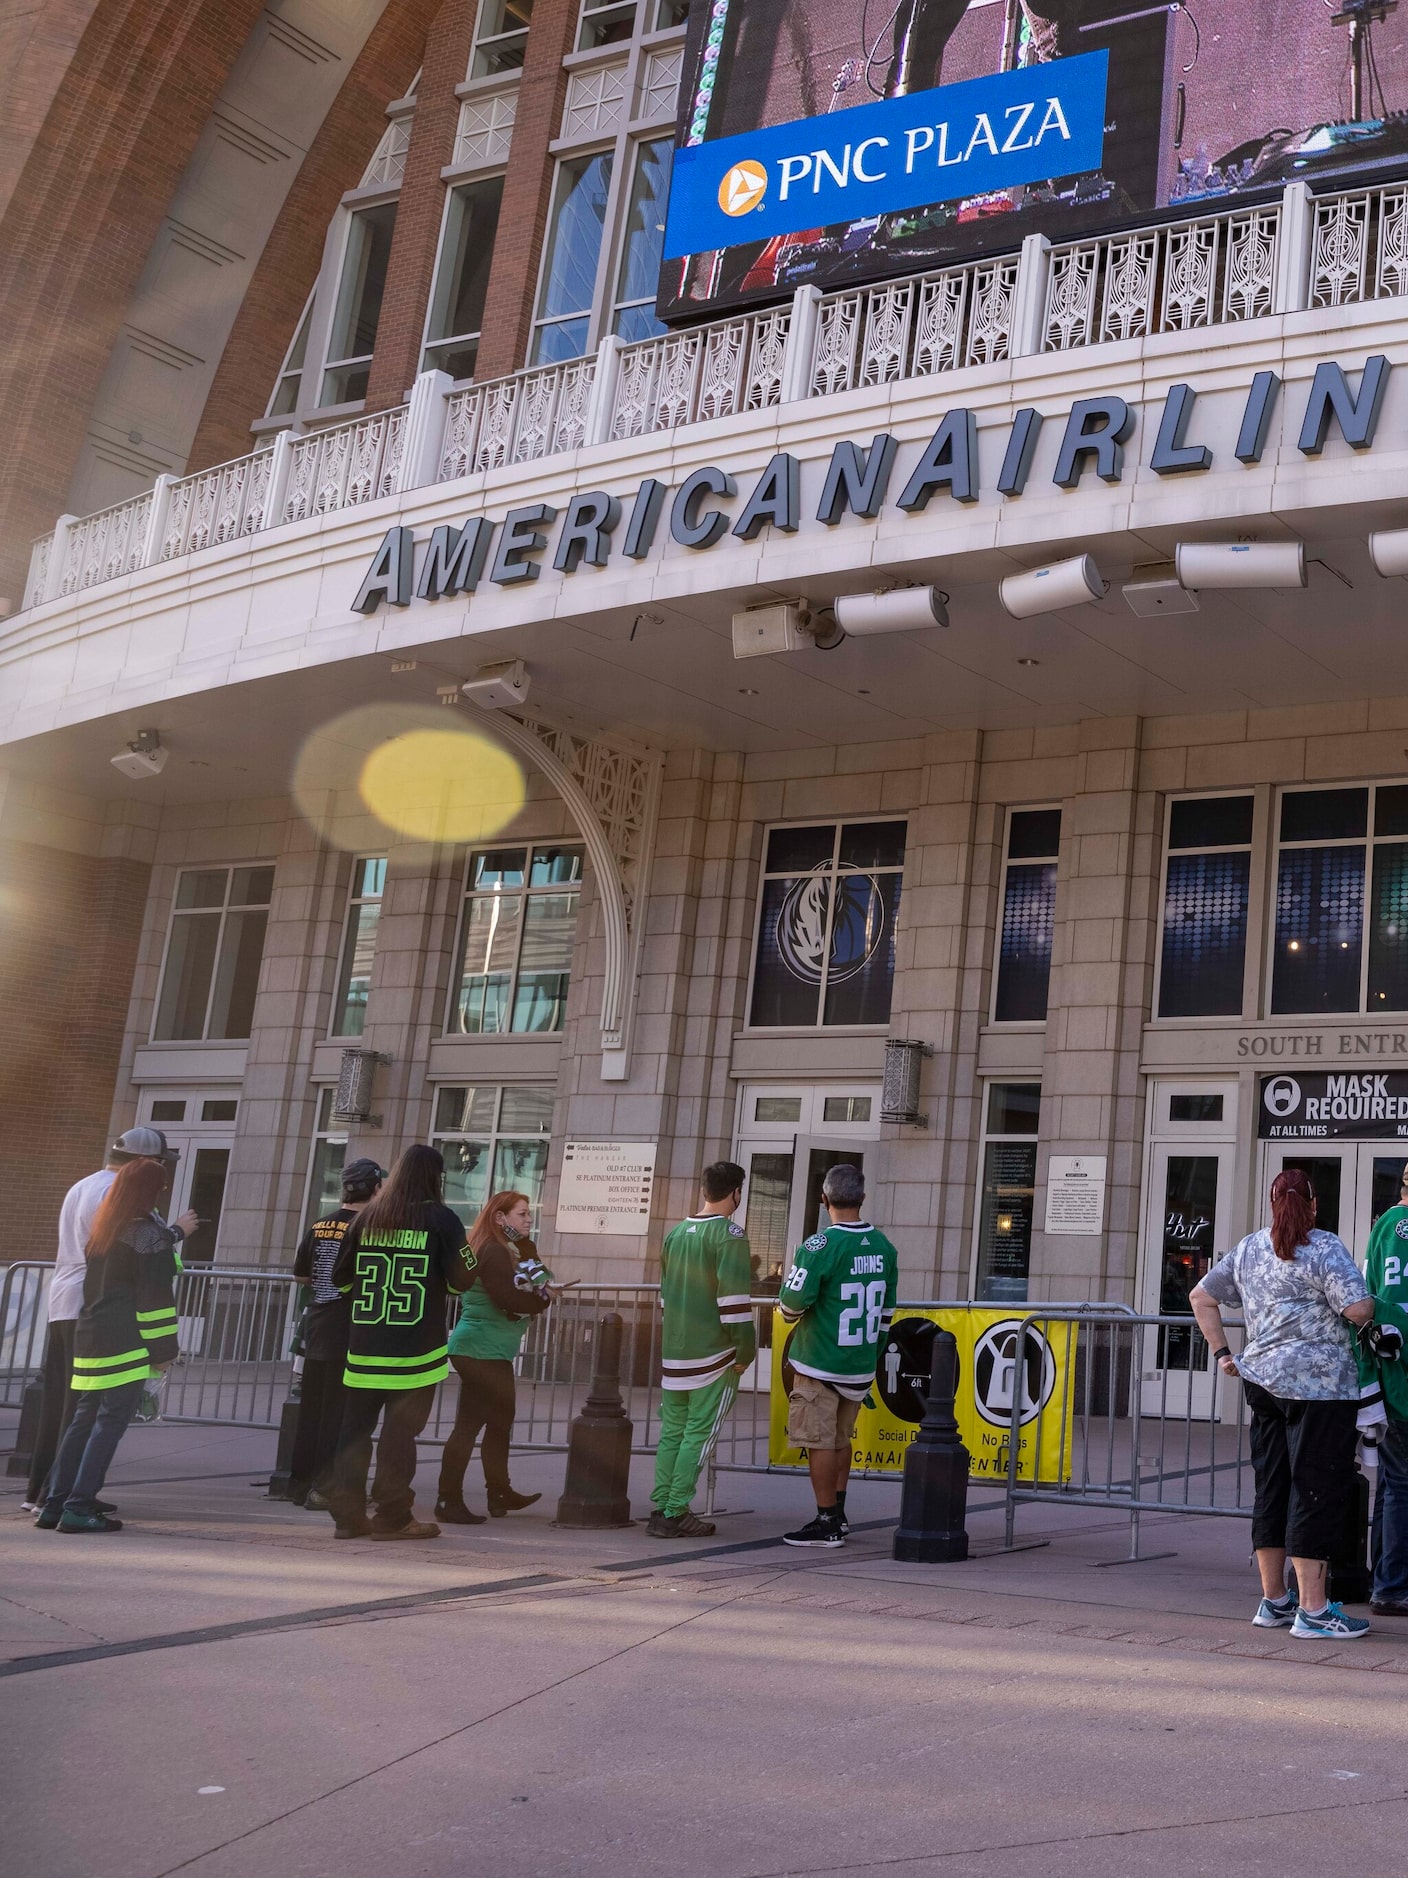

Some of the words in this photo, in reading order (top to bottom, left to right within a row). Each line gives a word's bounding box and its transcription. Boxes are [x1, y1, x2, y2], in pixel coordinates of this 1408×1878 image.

[778, 137, 889, 202] PNC
[904, 97, 1072, 175] PLAZA
[1237, 1036, 1323, 1056] SOUTH
[1326, 1075, 1389, 1098] MASK
[1269, 1126, 1281, 1136] AT
[1281, 1126, 1299, 1136] ALL
[1300, 1125, 1328, 1136] TIMES
[850, 1254, 884, 1276] JOHNS
[352, 1252, 429, 1325] 35
[837, 1280, 887, 1347] 28
[910, 1377, 923, 1388] 6ft
[878, 1429, 907, 1442] Social
[982, 1433, 998, 1446] No
